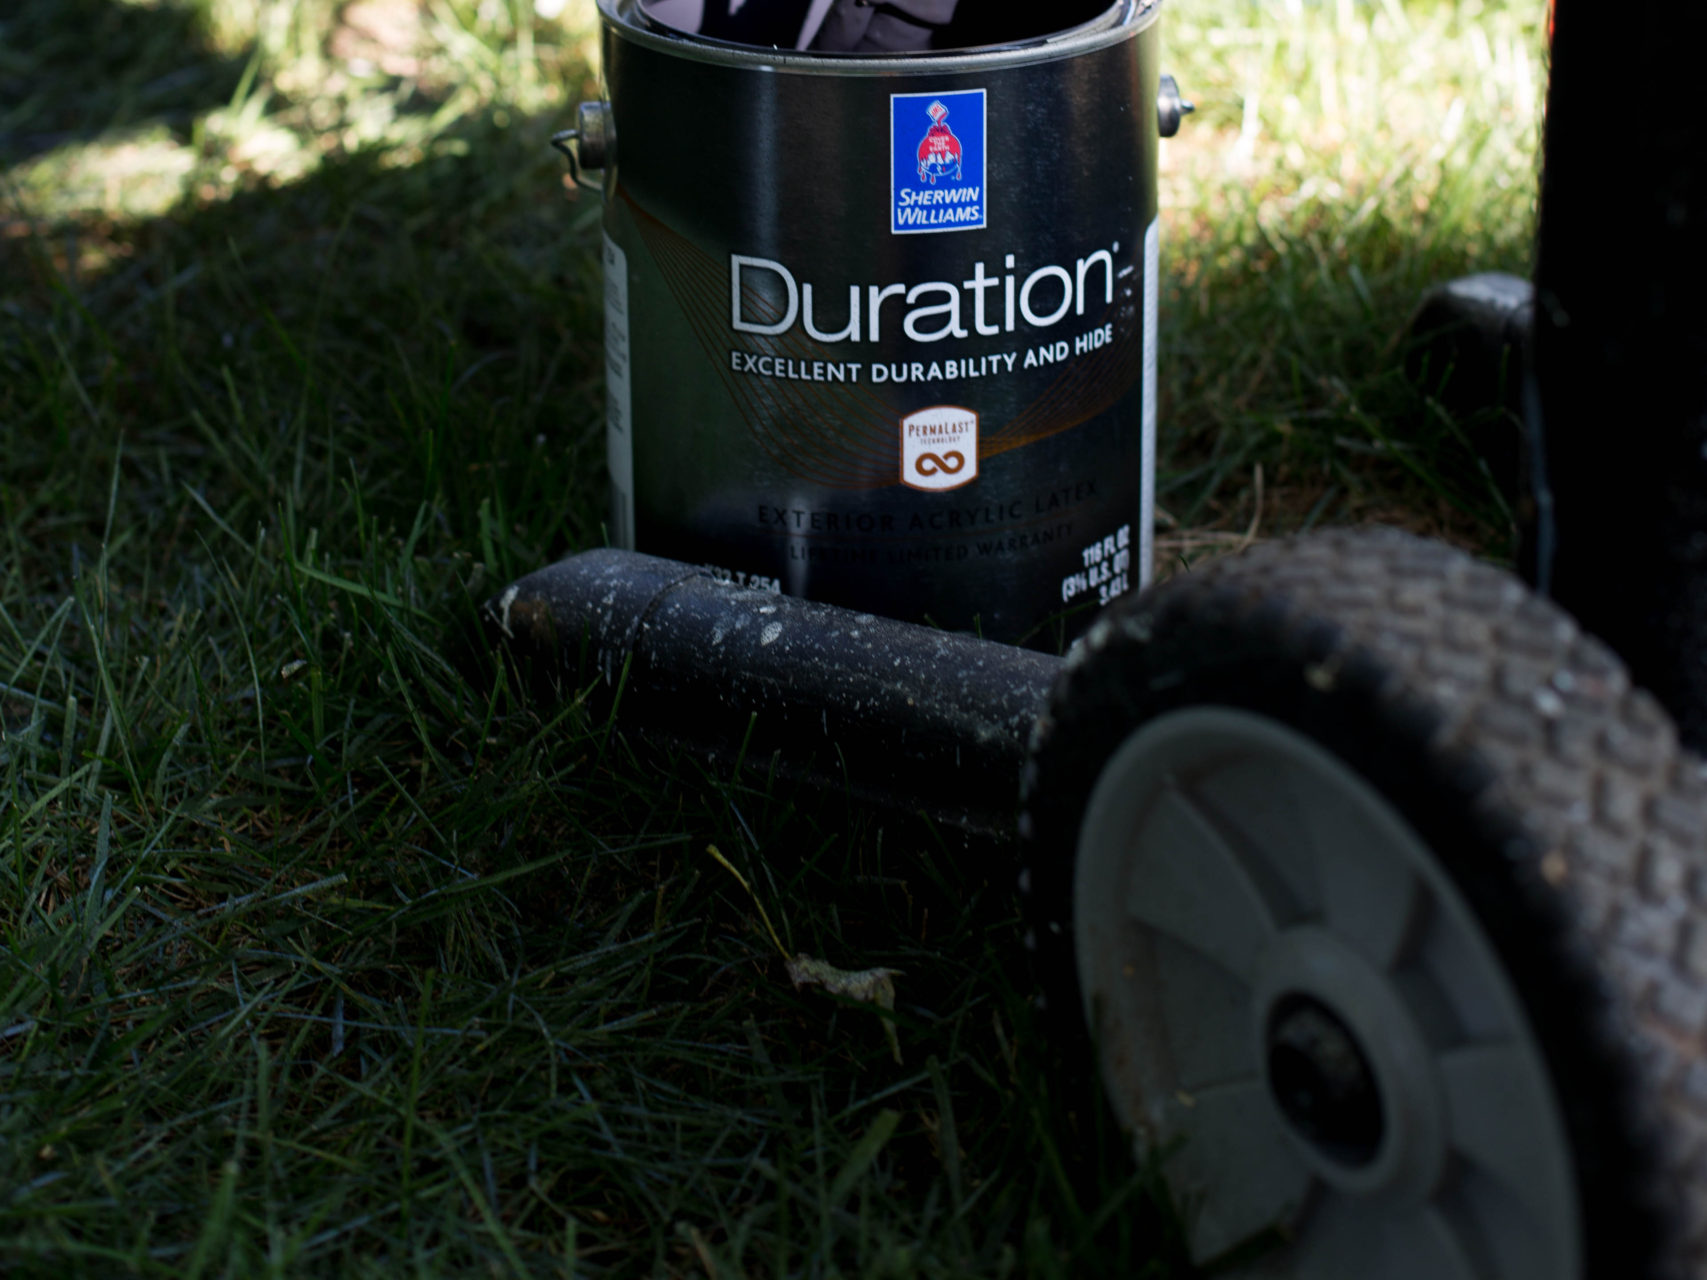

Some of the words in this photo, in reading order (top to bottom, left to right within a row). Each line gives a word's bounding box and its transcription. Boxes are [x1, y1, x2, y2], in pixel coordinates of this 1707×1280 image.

[897, 205, 980, 225] WILLIAMS
[898, 186, 980, 207] SHERWIN
[730, 248, 1114, 343] Duration
[732, 350, 862, 383] EXCELLENT
[871, 352, 1017, 384] DURABILITY
[1023, 340, 1069, 370] AND
[1074, 322, 1113, 357] HIDE
[759, 504, 894, 532] EXTERIOR
[909, 500, 1022, 531] ACRYLIC
[1035, 478, 1098, 514] LATEX
[976, 521, 1073, 556] WARRANTY
